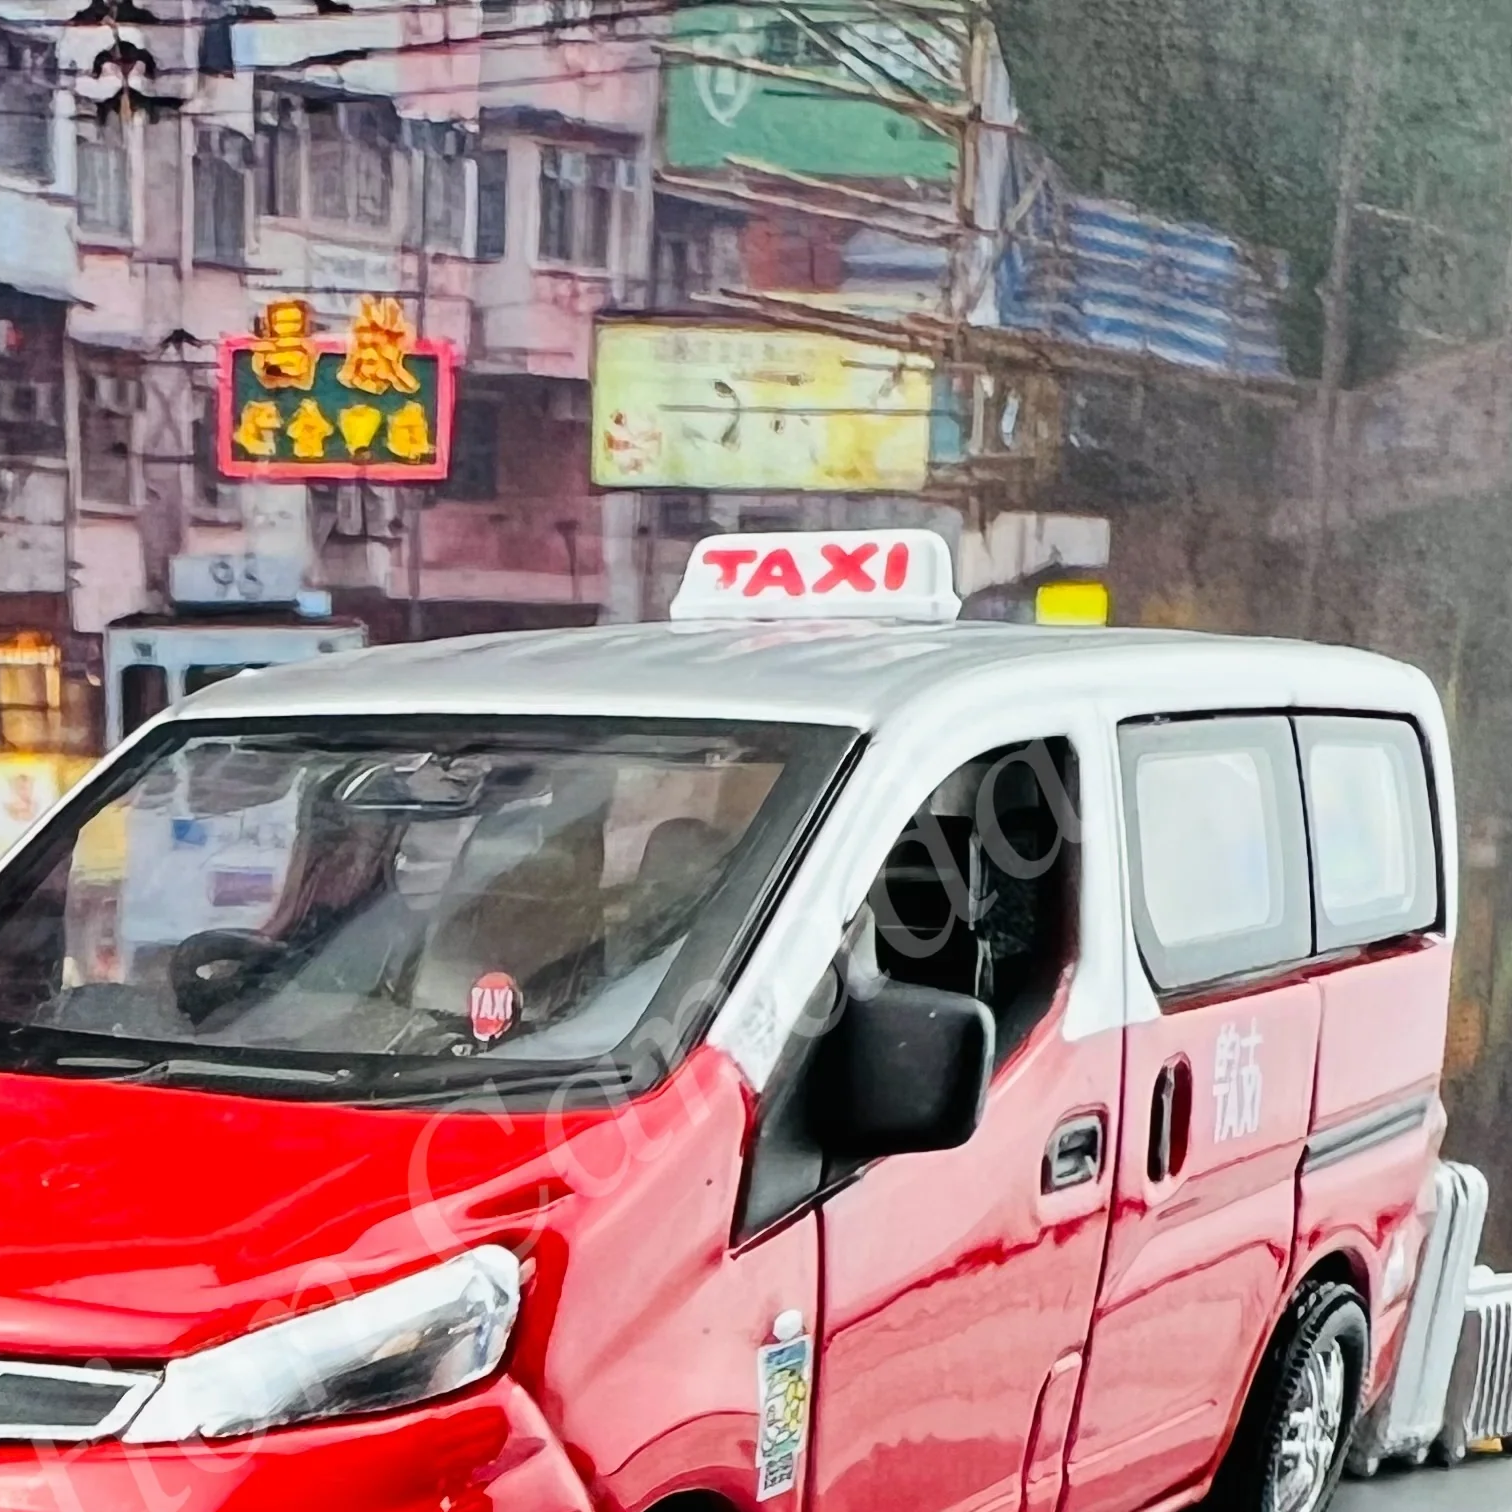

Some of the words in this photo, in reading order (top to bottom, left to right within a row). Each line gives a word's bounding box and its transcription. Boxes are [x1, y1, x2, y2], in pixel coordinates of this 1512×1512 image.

[702, 541, 909, 597] TAXI
[1215, 1017, 1264, 1081] 的士
[1213, 1065, 1262, 1144] TAXI
